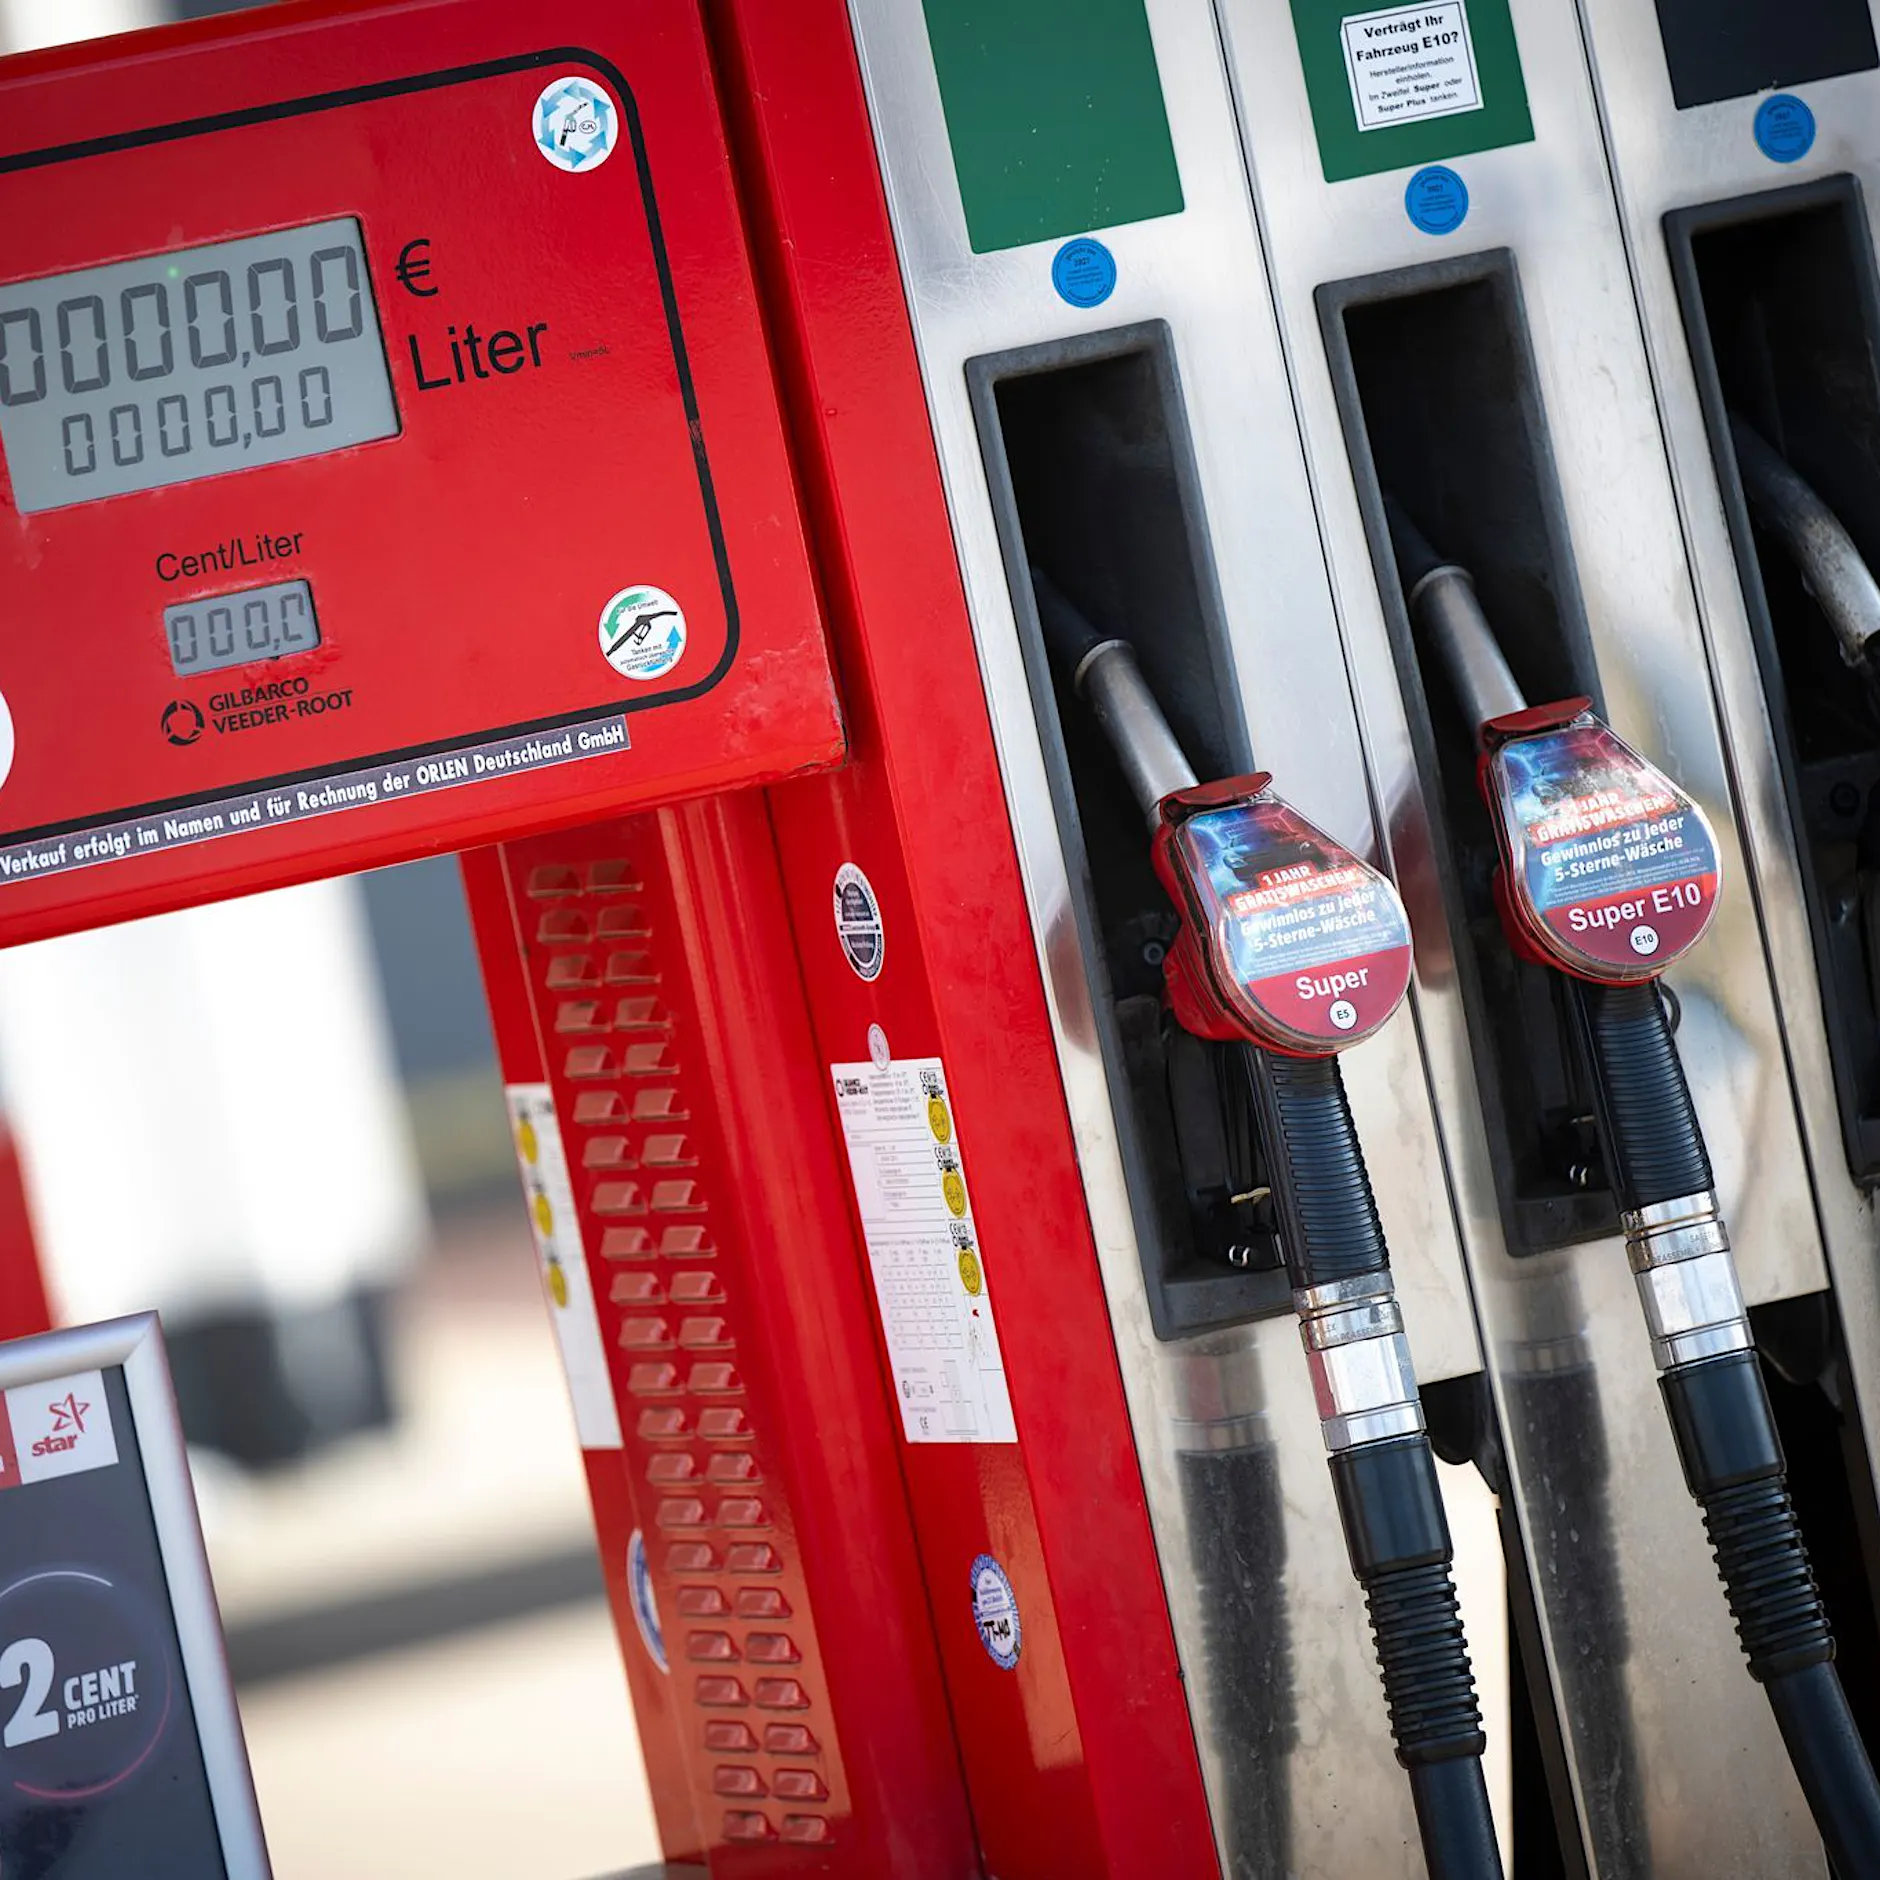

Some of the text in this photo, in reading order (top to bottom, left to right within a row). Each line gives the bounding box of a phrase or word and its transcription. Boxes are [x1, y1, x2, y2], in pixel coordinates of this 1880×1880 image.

[1364, 14, 1444, 38] Verträgt Ihr
[1356, 31, 1459, 61] Fahrzeug E10?
[1369, 56, 1455, 78] Herstellerinformation
[1381, 88, 1410, 99] Zweifel
[1413, 82, 1441, 93] Super
[1444, 77, 1463, 87] oder
[1377, 103, 1404, 113] Super
[1407, 98, 1427, 108] Plus
[394, 238, 438, 297] €
[408, 323, 548, 391] Liter
[156, 532, 304, 582] Cent/Liter
[209, 677, 309, 713] GILBARCO
[212, 690, 353, 734] VEEDER-ROOT
[0, 724, 625, 876] Verkauf erfolgt im Namen und für Rechnung der ORLEN Deutschland GmbH
[1541, 816, 1685, 867] Gewinnlos zu jeder
[1273, 865, 1313, 885] JAHR
[1555, 836, 1684, 883] 5-Sterne-Wäsche
[1318, 901, 1336, 915] zu
[1568, 898, 1646, 932] Super
[1651, 882, 1702, 914] E10
[1253, 910, 1376, 952] 5-Sterne-Wäsche
[1635, 933, 1654, 946] E10
[1296, 967, 1369, 1000] Super
[1336, 1009, 1350, 1021] E5
[32, 1433, 78, 1457] star
[0, 1637, 137, 1748] 2 CENT
[67, 1707, 96, 1729] PRO
